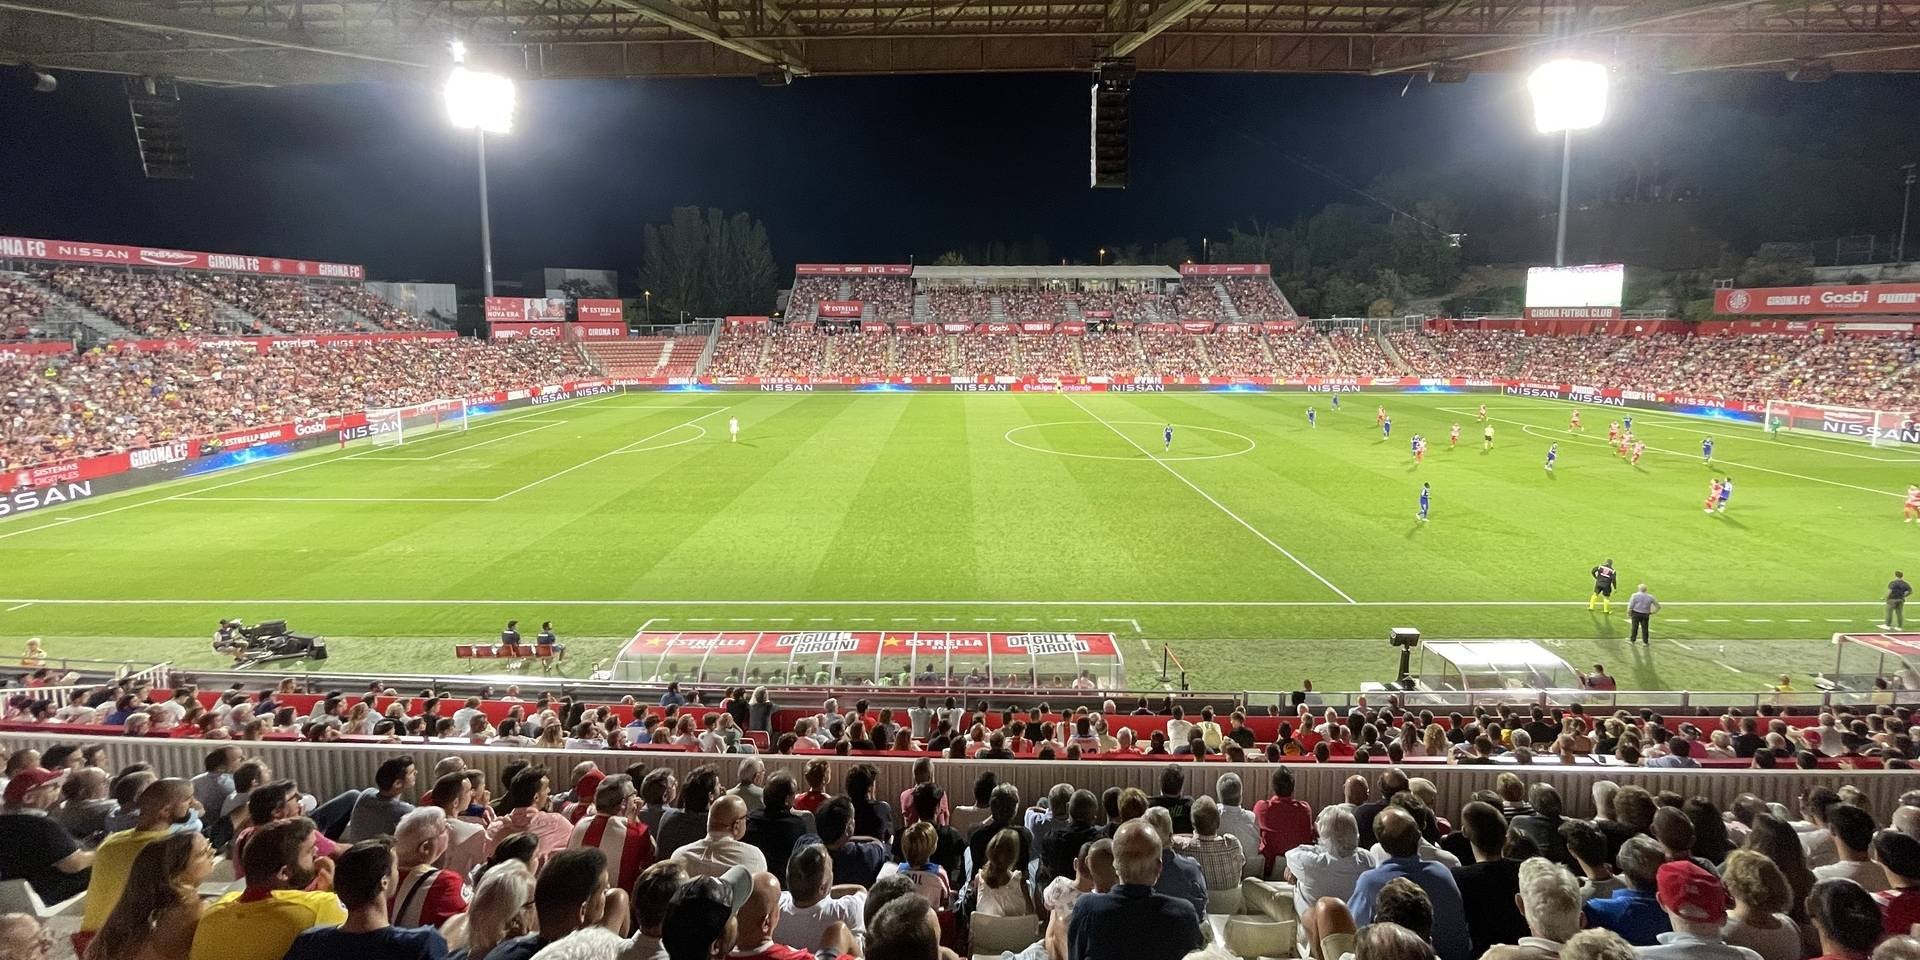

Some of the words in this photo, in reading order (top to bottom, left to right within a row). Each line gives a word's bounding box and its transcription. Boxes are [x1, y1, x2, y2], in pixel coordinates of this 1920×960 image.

[0, 238, 24, 257] NA
[27, 240, 47, 258] FC
[58, 246, 129, 259] NISSAN
[208, 255, 245, 271] GIRONA
[246, 257, 260, 272] FC
[319, 264, 348, 277] GIRONA
[350, 265, 361, 277] FC
[1767, 296, 1799, 306] GIRONA
[1799, 295, 1811, 305] FC
[1820, 291, 1869, 305] Gosbi
[1531, 309, 1560, 318] GIRONA
[1561, 309, 1589, 318] FUTBOL
[1591, 308, 1613, 318] CLUB
[530, 327, 560, 336] Gosbi
[576, 386, 616, 398] NISSAN
[1112, 384, 1165, 392] NISSAN
[1307, 384, 1361, 392] NISSAN
[1507, 386, 1559, 399] NISSAN
[531, 392, 570, 405] NISSAN
[1568, 392, 1625, 406] NISSAN
[1675, 396, 1726, 408] NISSAN
[295, 420, 327, 436] Gosbi
[339, 421, 400, 440] NISSAN
[1823, 421, 1920, 443] NISSAN
[130, 447, 173, 468] GIRONA
[174, 443, 188, 458] FC
[33, 463, 79, 478] SISTEMAS
[905, 639, 984, 647] ESTRELLA
